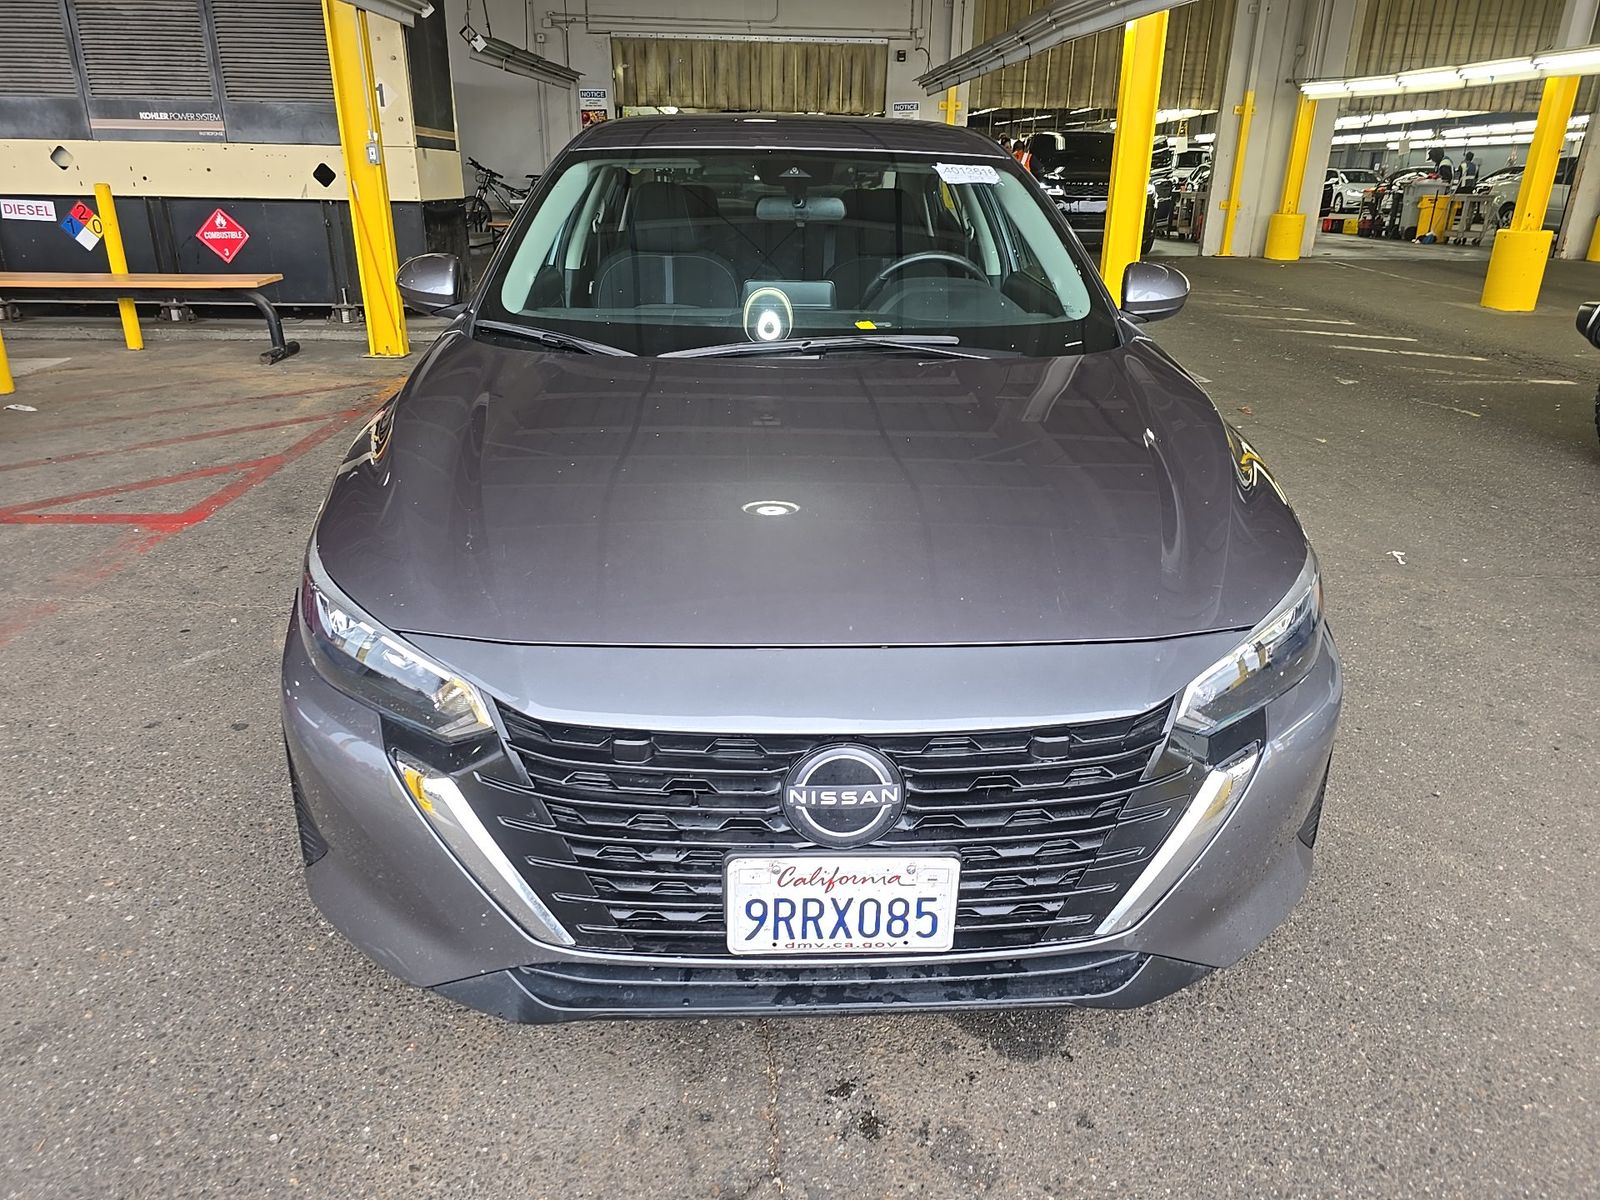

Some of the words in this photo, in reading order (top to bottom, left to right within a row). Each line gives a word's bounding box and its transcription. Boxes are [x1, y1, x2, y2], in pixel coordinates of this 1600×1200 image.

[139, 112, 169, 120] KOHLER
[196, 113, 221, 121] SYSTEM
[3, 203, 53, 217] DIESEL
[76, 204, 88, 220] 2
[66, 218, 76, 235] 1
[92, 218, 103, 234] 0
[203, 231, 243, 239] COMBUSTIBLE
[223, 248, 230, 257] 3
[789, 787, 898, 806] NISSAN
[776, 866, 917, 893] California
[745, 897, 938, 940] 9RRX085
[784, 941, 898, 949] dmv.ca.gov
